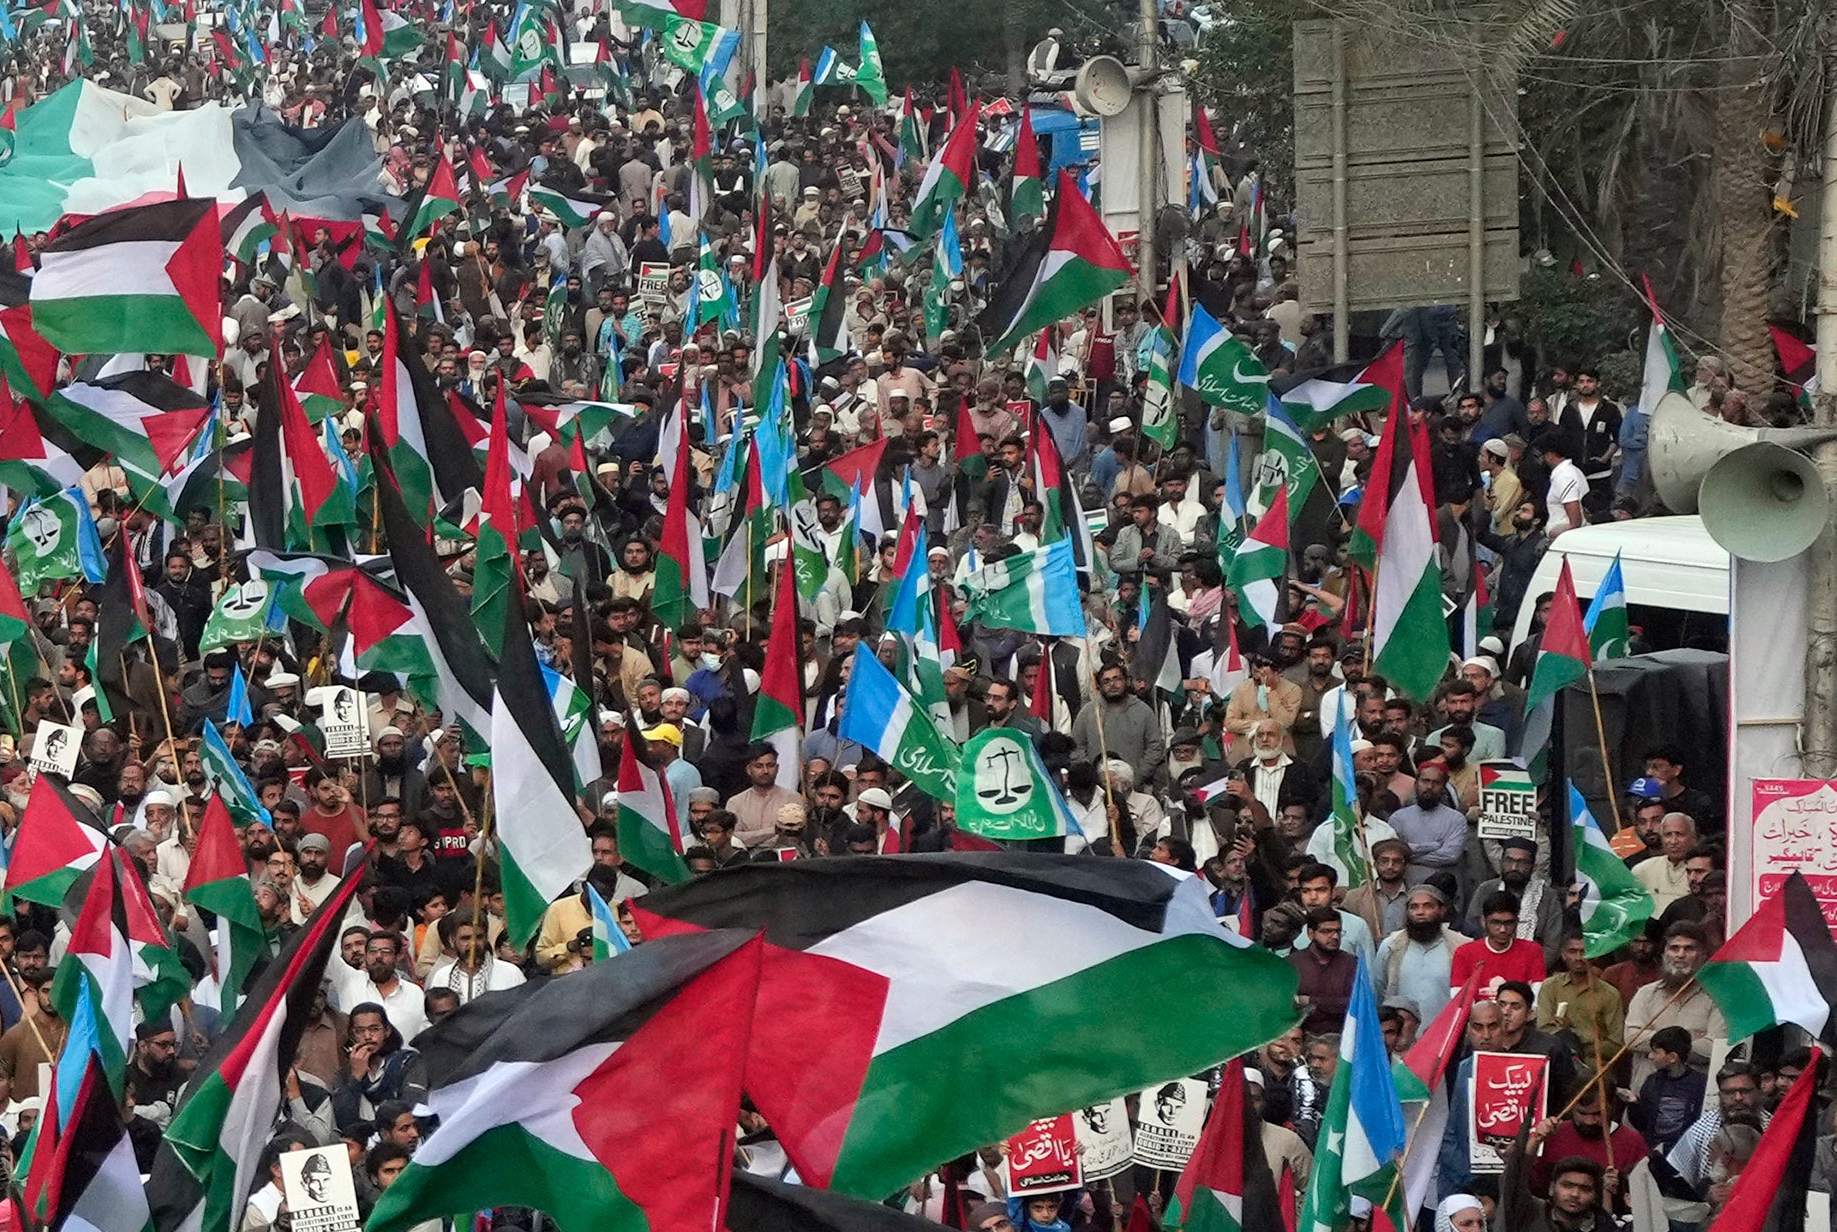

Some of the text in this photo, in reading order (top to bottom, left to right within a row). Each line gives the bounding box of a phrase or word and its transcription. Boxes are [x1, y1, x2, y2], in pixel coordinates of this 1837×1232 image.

[1482, 792, 1535, 814] FREE
[1483, 813, 1534, 827] PALESTINE
[1140, 1121, 1179, 1138] ISRAEL
[293, 1205, 336, 1220] ISRAEL
